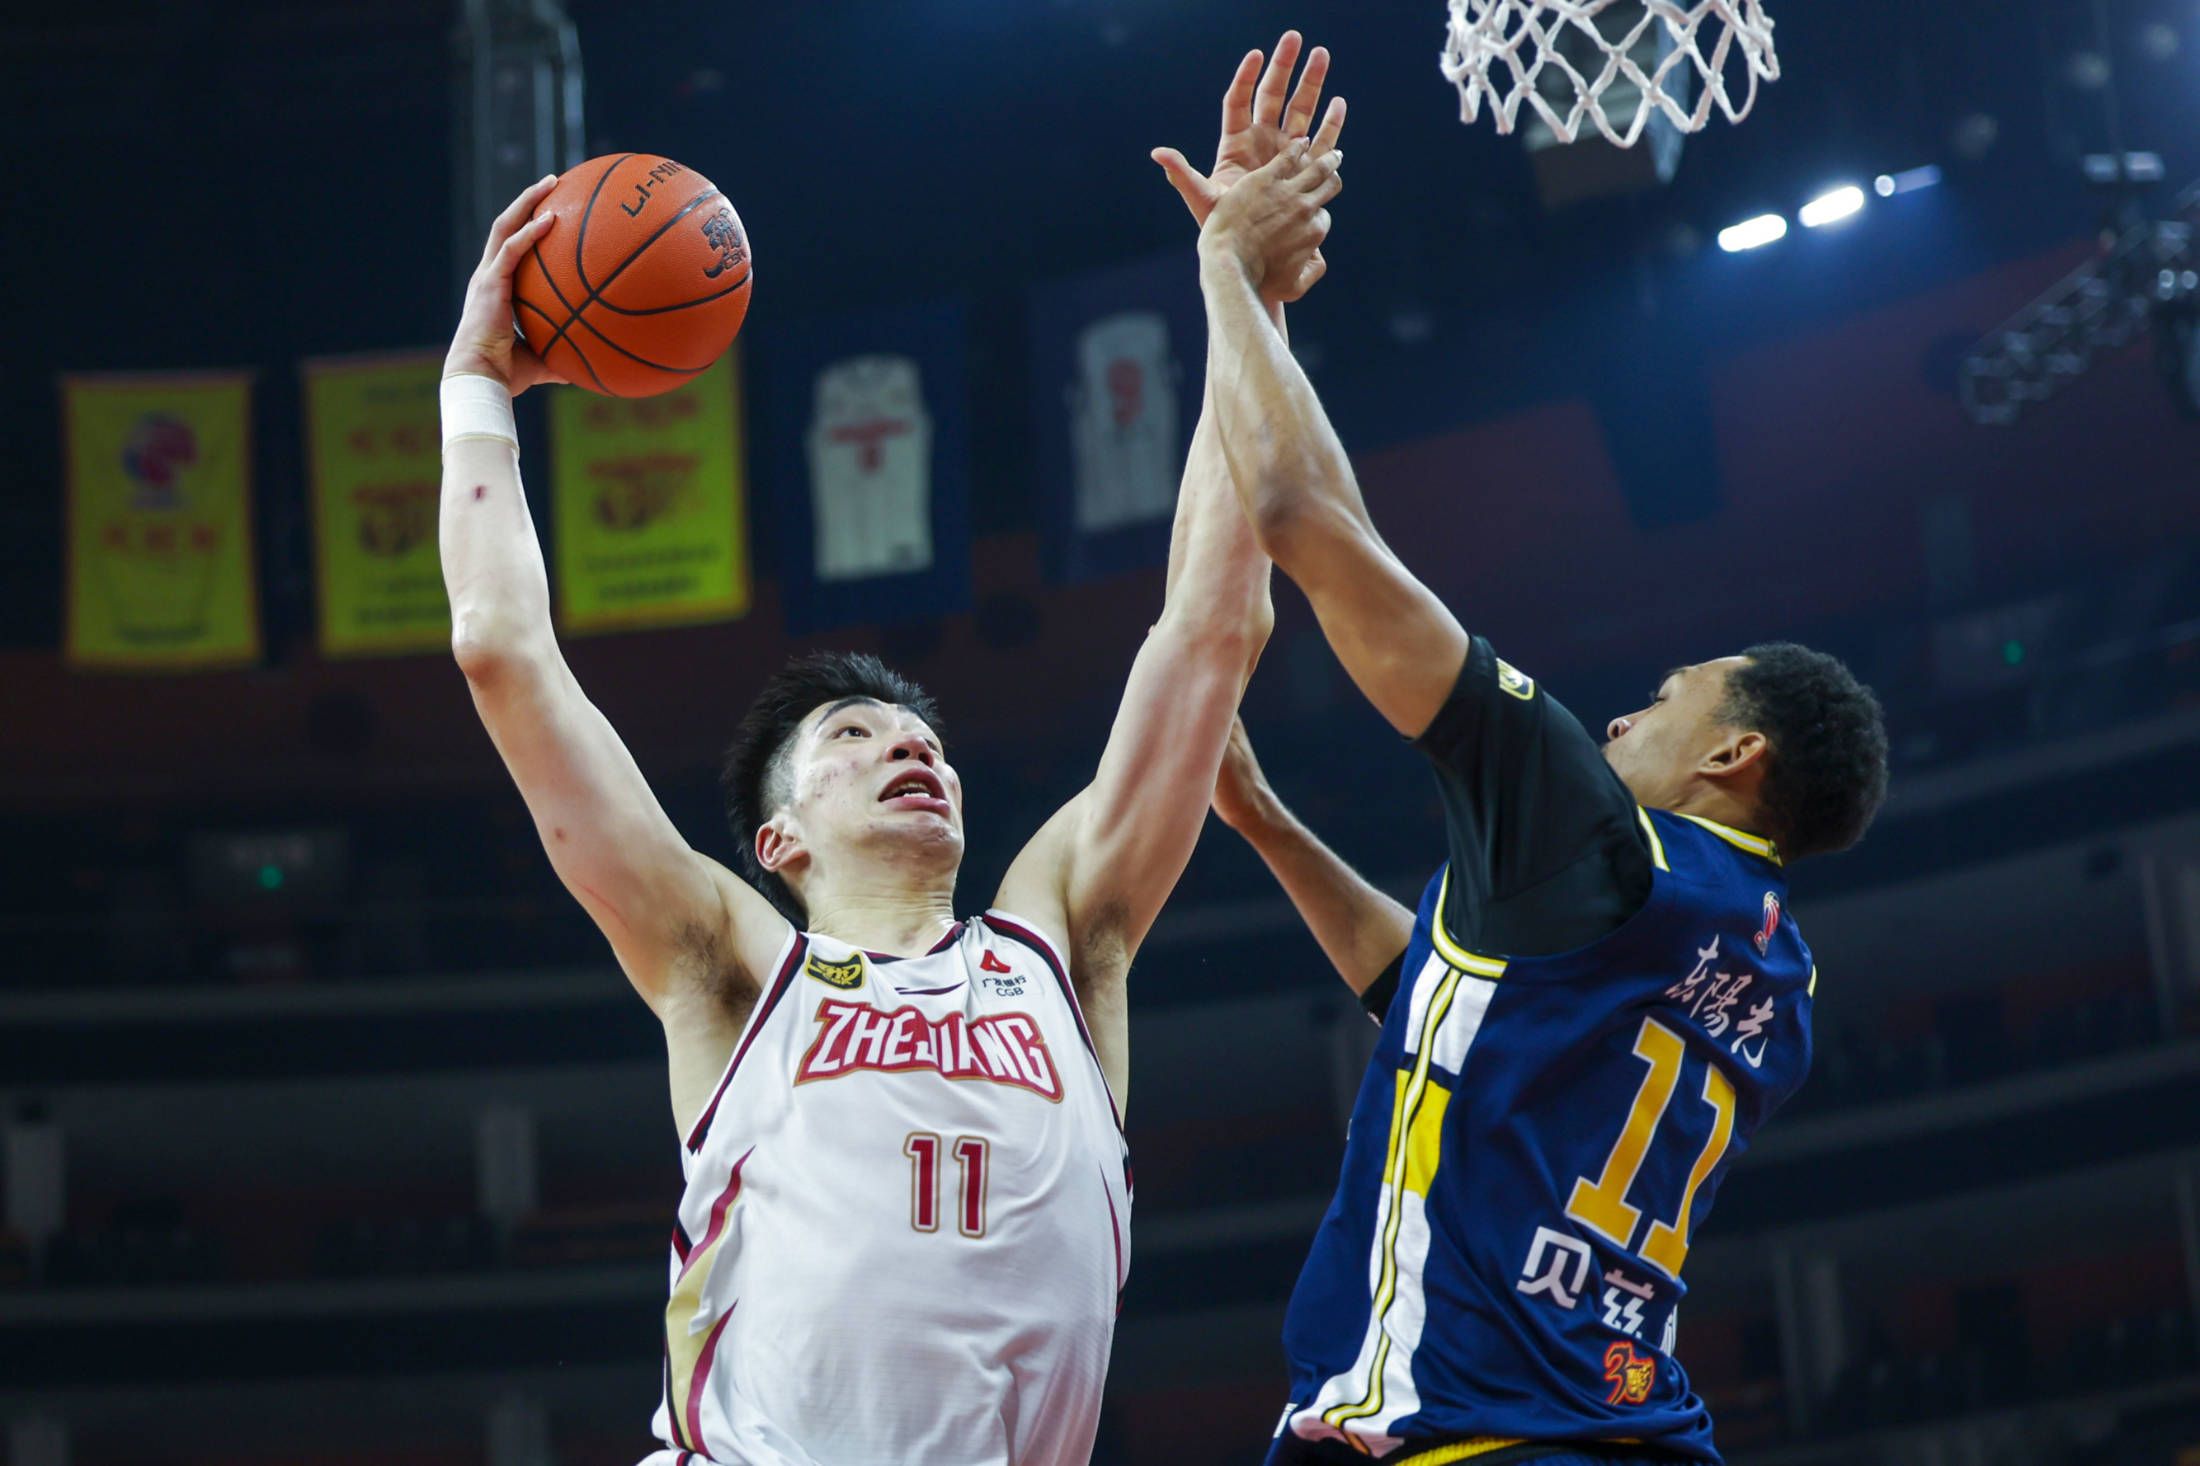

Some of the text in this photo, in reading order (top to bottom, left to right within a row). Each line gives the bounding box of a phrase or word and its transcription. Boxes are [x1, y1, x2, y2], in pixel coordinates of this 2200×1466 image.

[996, 986, 1024, 997] CGB
[796, 999, 1063, 1102] ZHEJIANG
[903, 1132, 990, 1239] 11
[1565, 1016, 1736, 1281] 11
